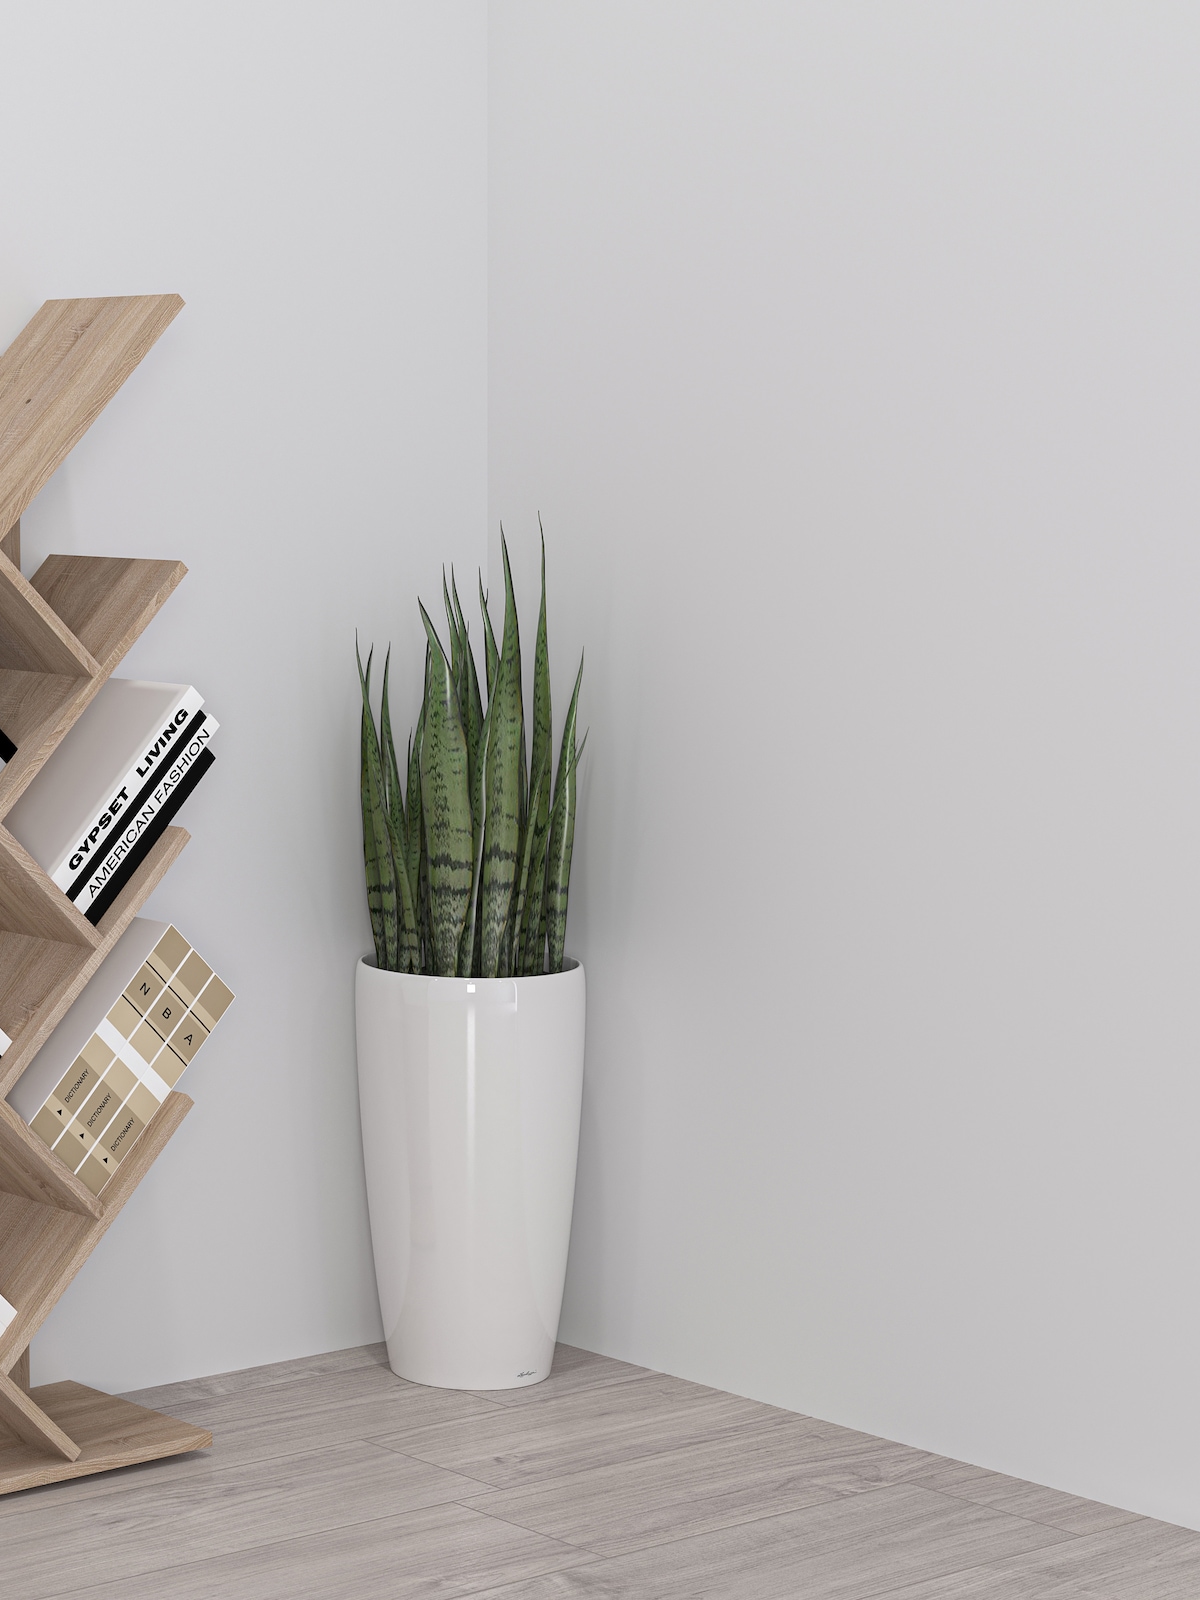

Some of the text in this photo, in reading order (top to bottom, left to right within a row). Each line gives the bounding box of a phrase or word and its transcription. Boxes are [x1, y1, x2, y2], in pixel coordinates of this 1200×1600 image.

[68, 708, 189, 871] GYPSET LIVING
[88, 728, 210, 898] AMERICAN FASHION
[64, 1068, 90, 1104] DICTIONARY
[87, 1092, 112, 1127] DICTIONARY
[110, 1117, 135, 1152] DICTIONARY
